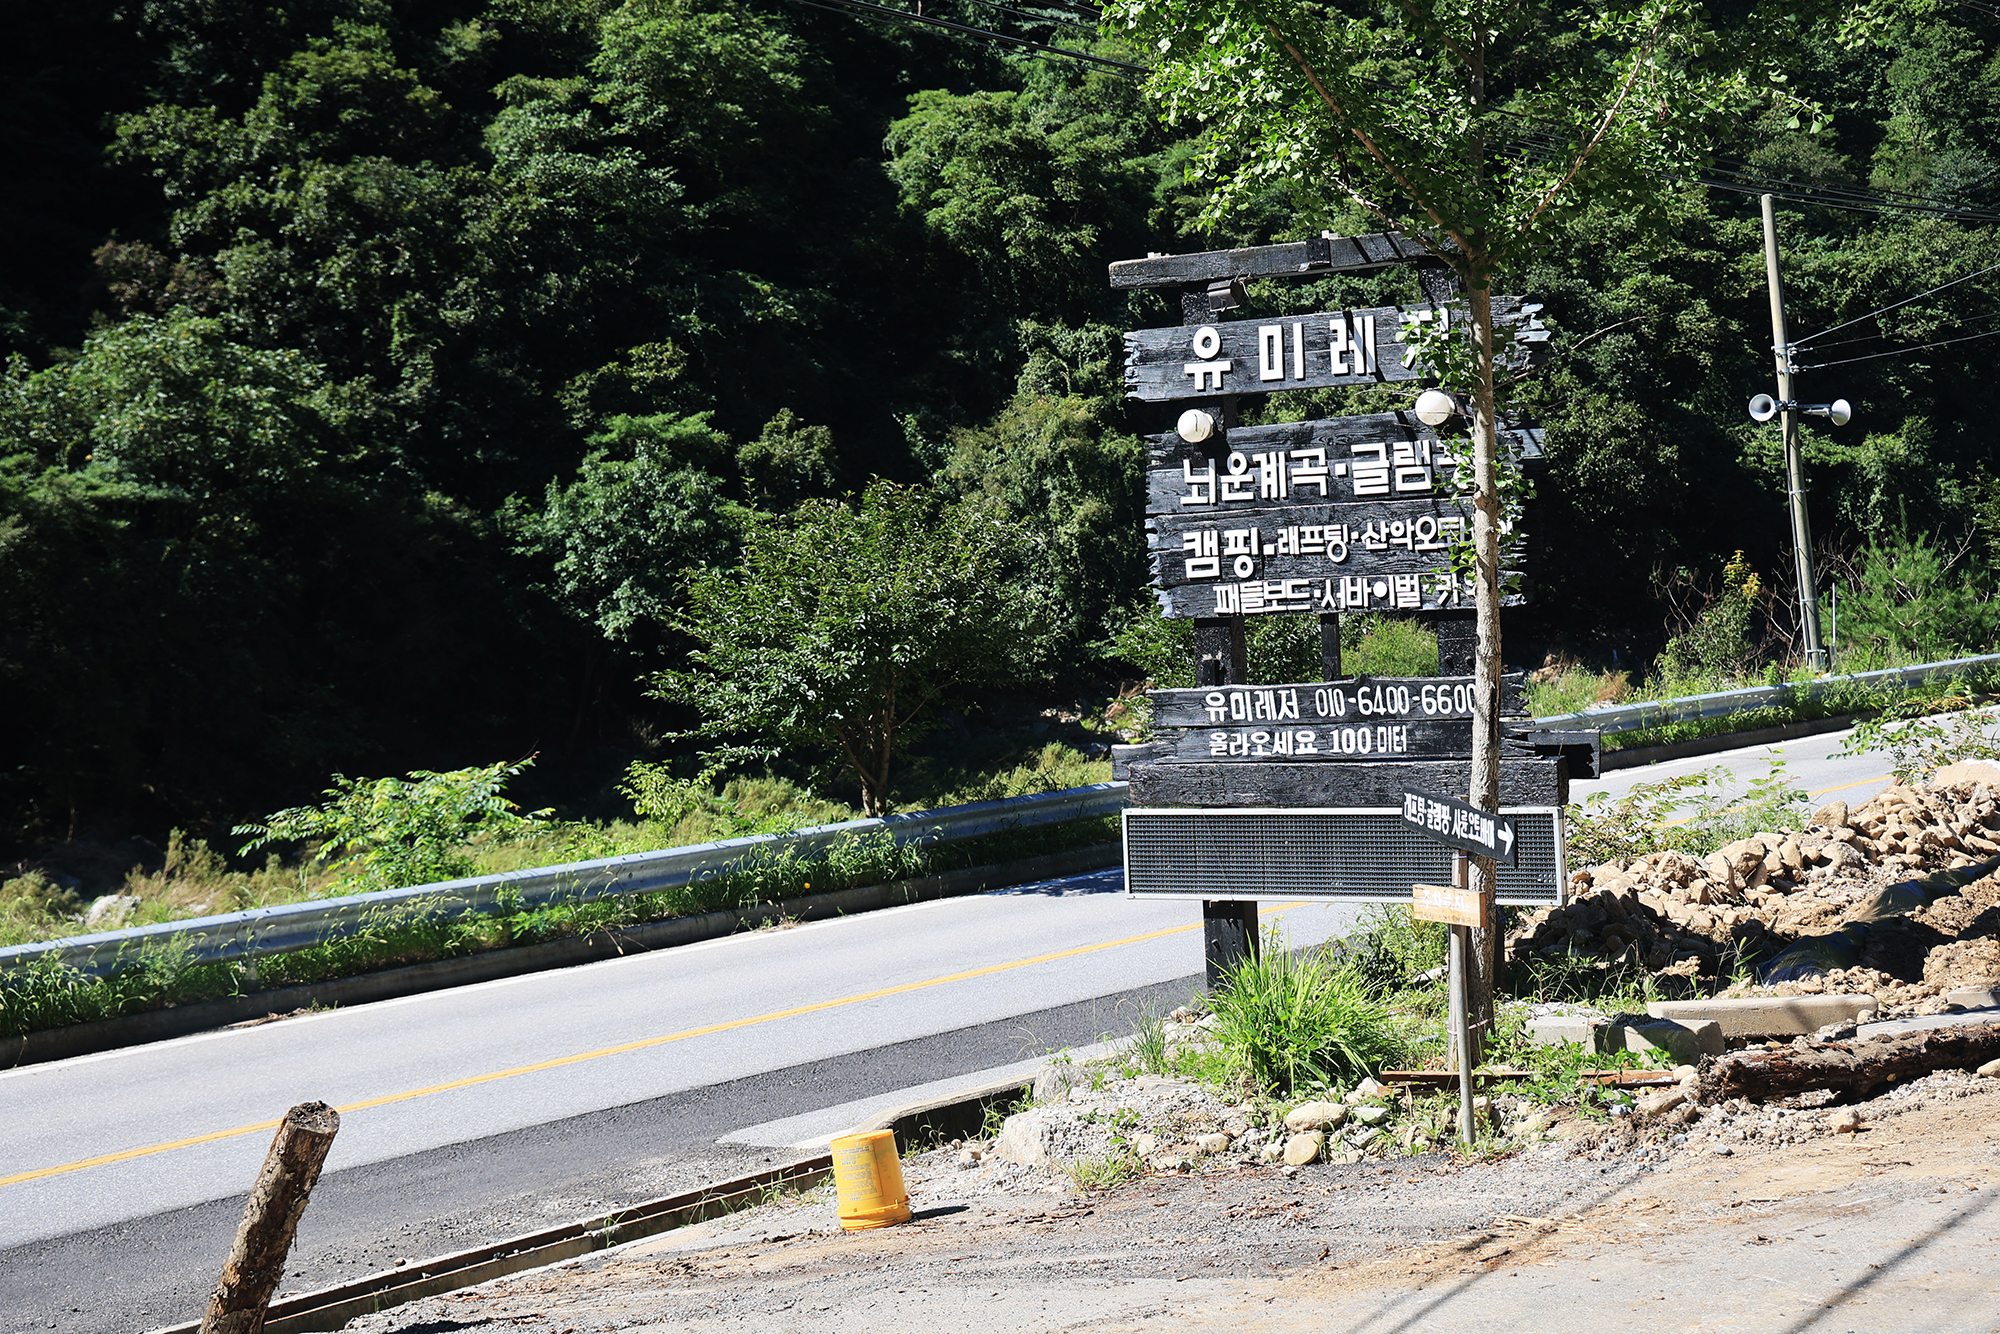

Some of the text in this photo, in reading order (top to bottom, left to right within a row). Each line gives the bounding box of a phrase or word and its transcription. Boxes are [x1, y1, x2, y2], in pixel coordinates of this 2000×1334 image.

[1205, 683, 1475, 721] 유미레저 010-6400-6600
[1209, 725, 1407, 756] 올라오세요 100 미터
[1421, 889, 1465, 912] 주차금지
